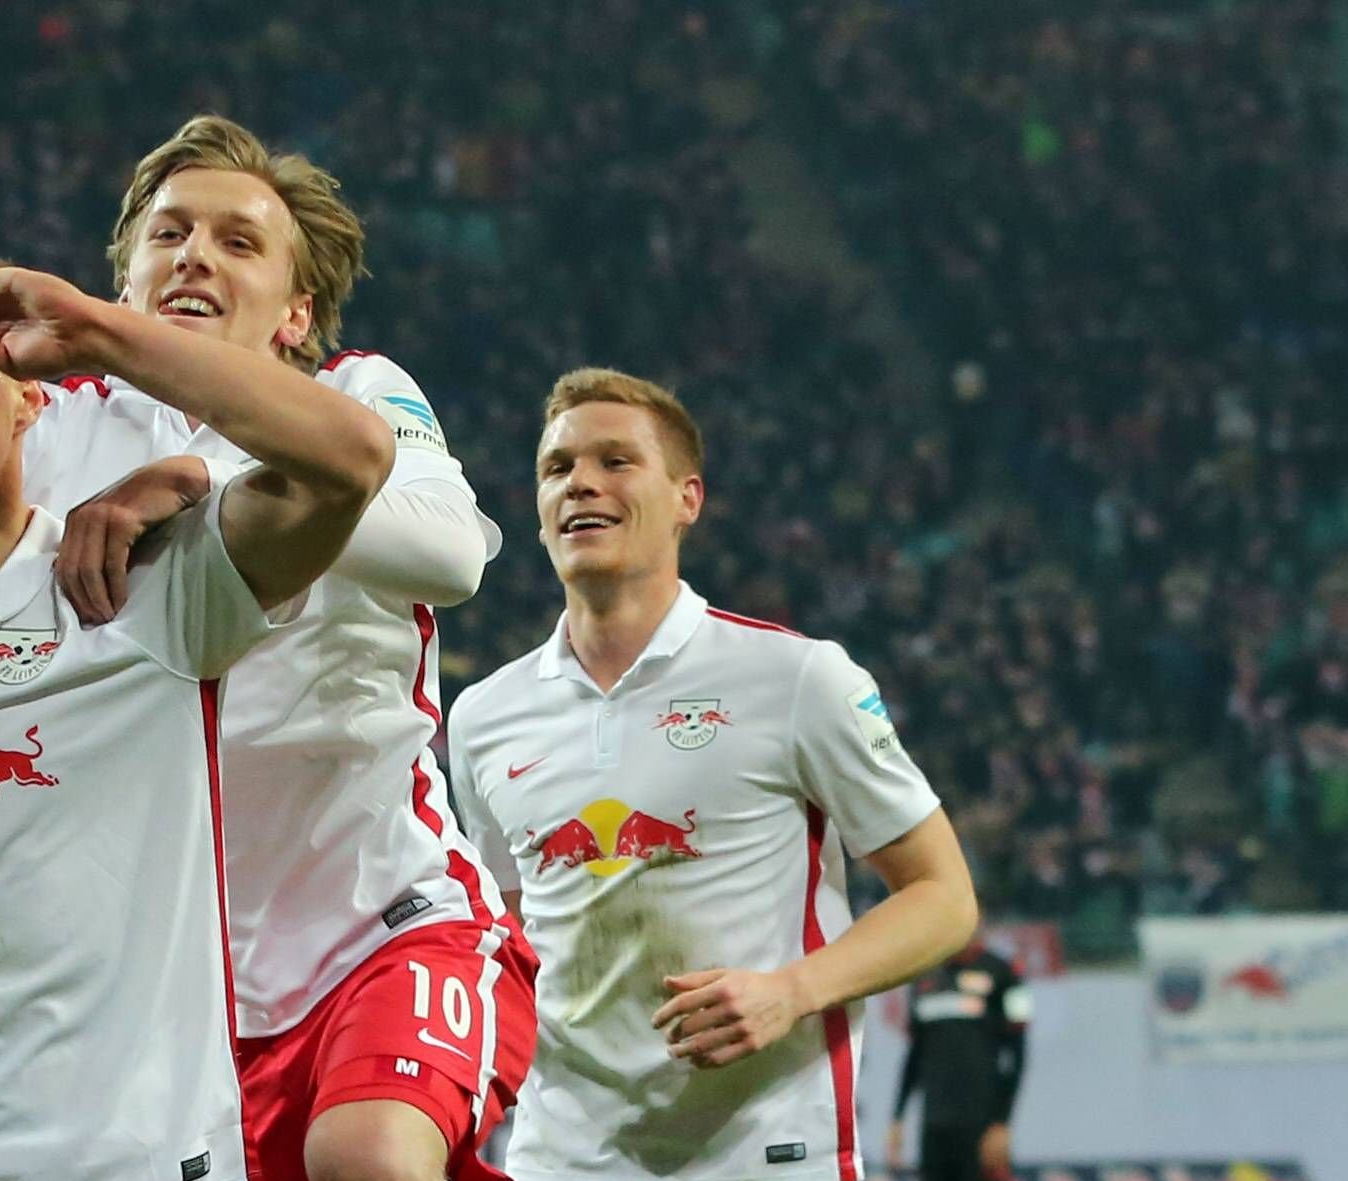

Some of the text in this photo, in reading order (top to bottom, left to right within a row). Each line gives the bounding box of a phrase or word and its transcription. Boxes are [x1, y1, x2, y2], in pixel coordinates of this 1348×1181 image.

[393, 426, 446, 450] Herme
[406, 960, 473, 1040] 10
[395, 1057, 420, 1077] M
